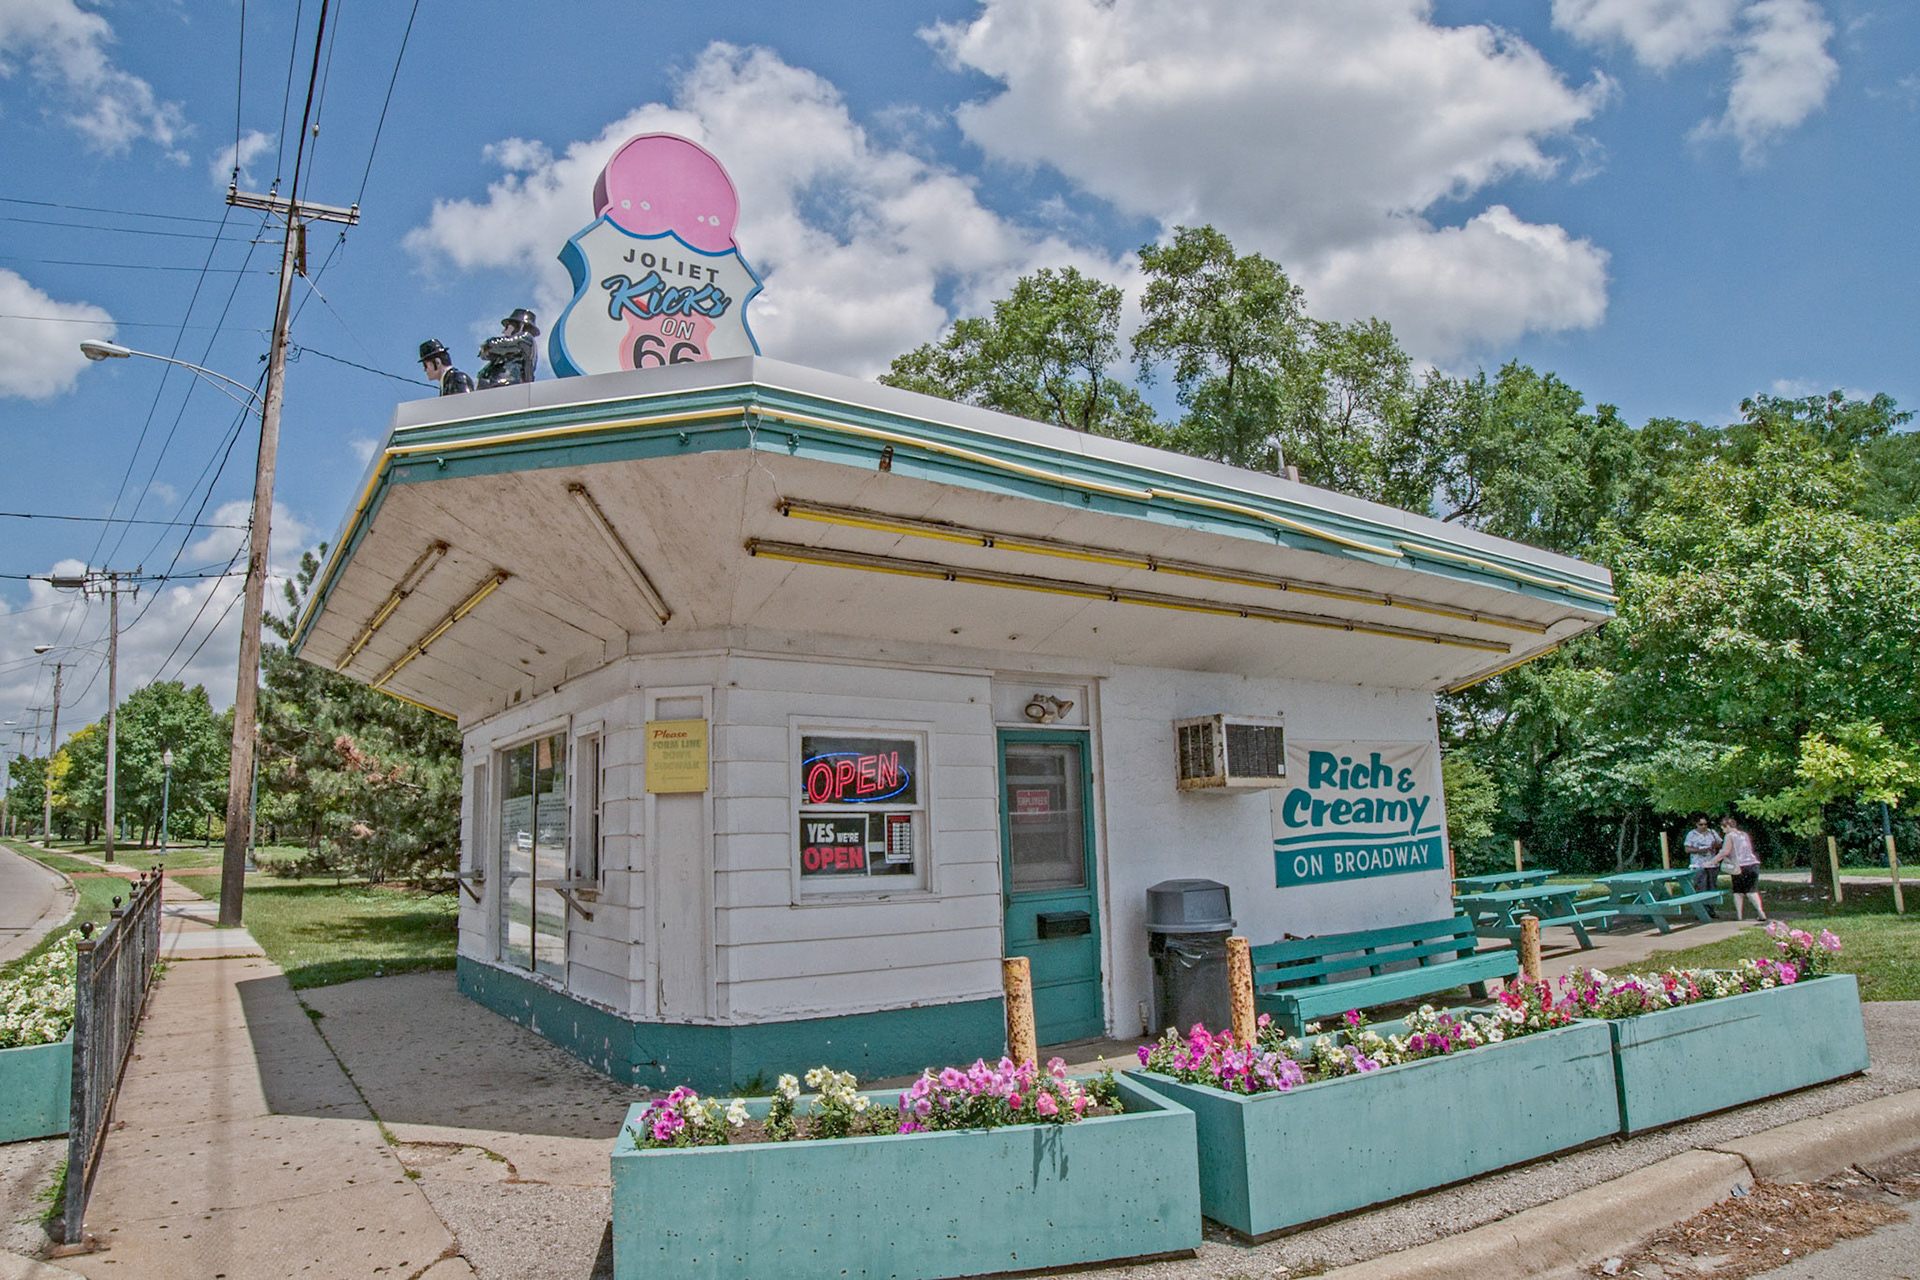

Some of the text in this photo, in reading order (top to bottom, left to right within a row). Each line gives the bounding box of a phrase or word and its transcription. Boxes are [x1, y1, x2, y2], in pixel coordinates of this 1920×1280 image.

[623, 249, 719, 283] JOLIET
[601, 270, 732, 321] Kicks
[661, 318, 695, 340] ON
[653, 729, 688, 739] Please
[653, 739, 702, 749] FORM LINE
[807, 751, 898, 803] OPEN
[1308, 750, 1416, 793] Rich &
[1282, 788, 1431, 836] Creamy
[807, 823, 859, 843] YES WE'RE
[803, 846, 864, 870] OPEN
[1293, 844, 1429, 878] ON BROADWAY
